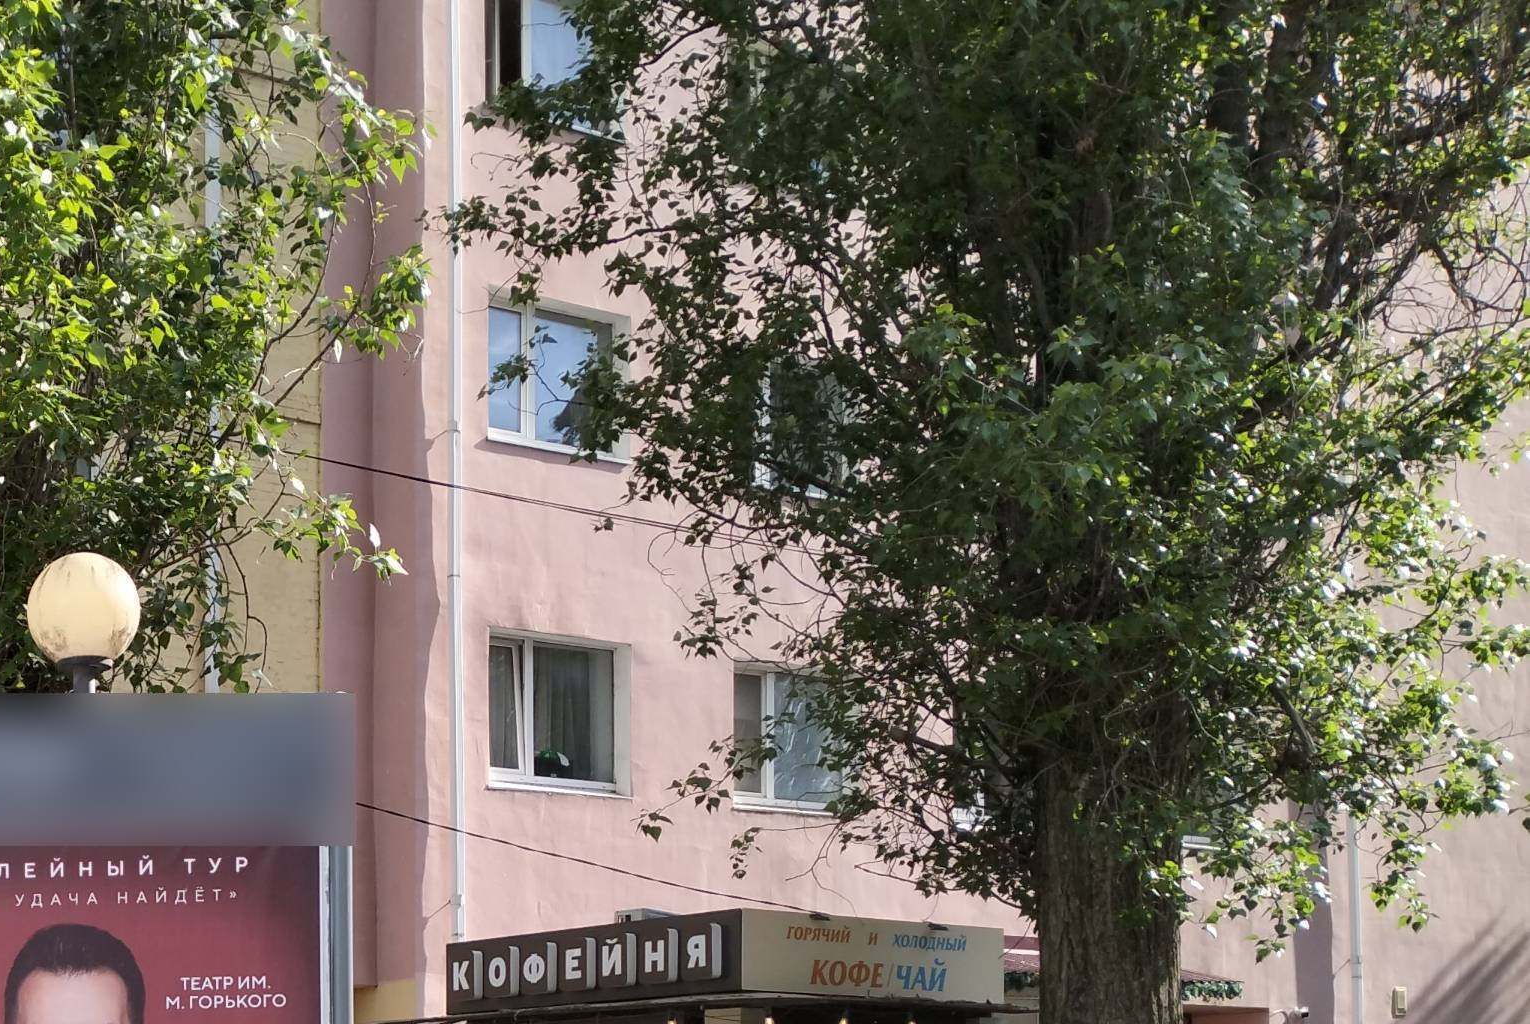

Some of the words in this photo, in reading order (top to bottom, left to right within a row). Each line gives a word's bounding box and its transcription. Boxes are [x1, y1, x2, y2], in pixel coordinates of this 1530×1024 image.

[183, 856, 249, 874] ТУР
[15, 890, 99, 908] УДАЧА
[117, 886, 238, 906] НАЙДЁТ»
[786, 925, 851, 943] ГОРЯЧИЙ
[892, 933, 967, 952] ХОЛОДНЫЙ
[452, 934, 708, 992] КОФЕЙНЯ
[180, 976, 234, 991] ТЕАТР
[237, 975, 271, 990] ИМ.
[165, 996, 185, 1010] М.
[189, 993, 287, 1009] ГОРЬКОГО
